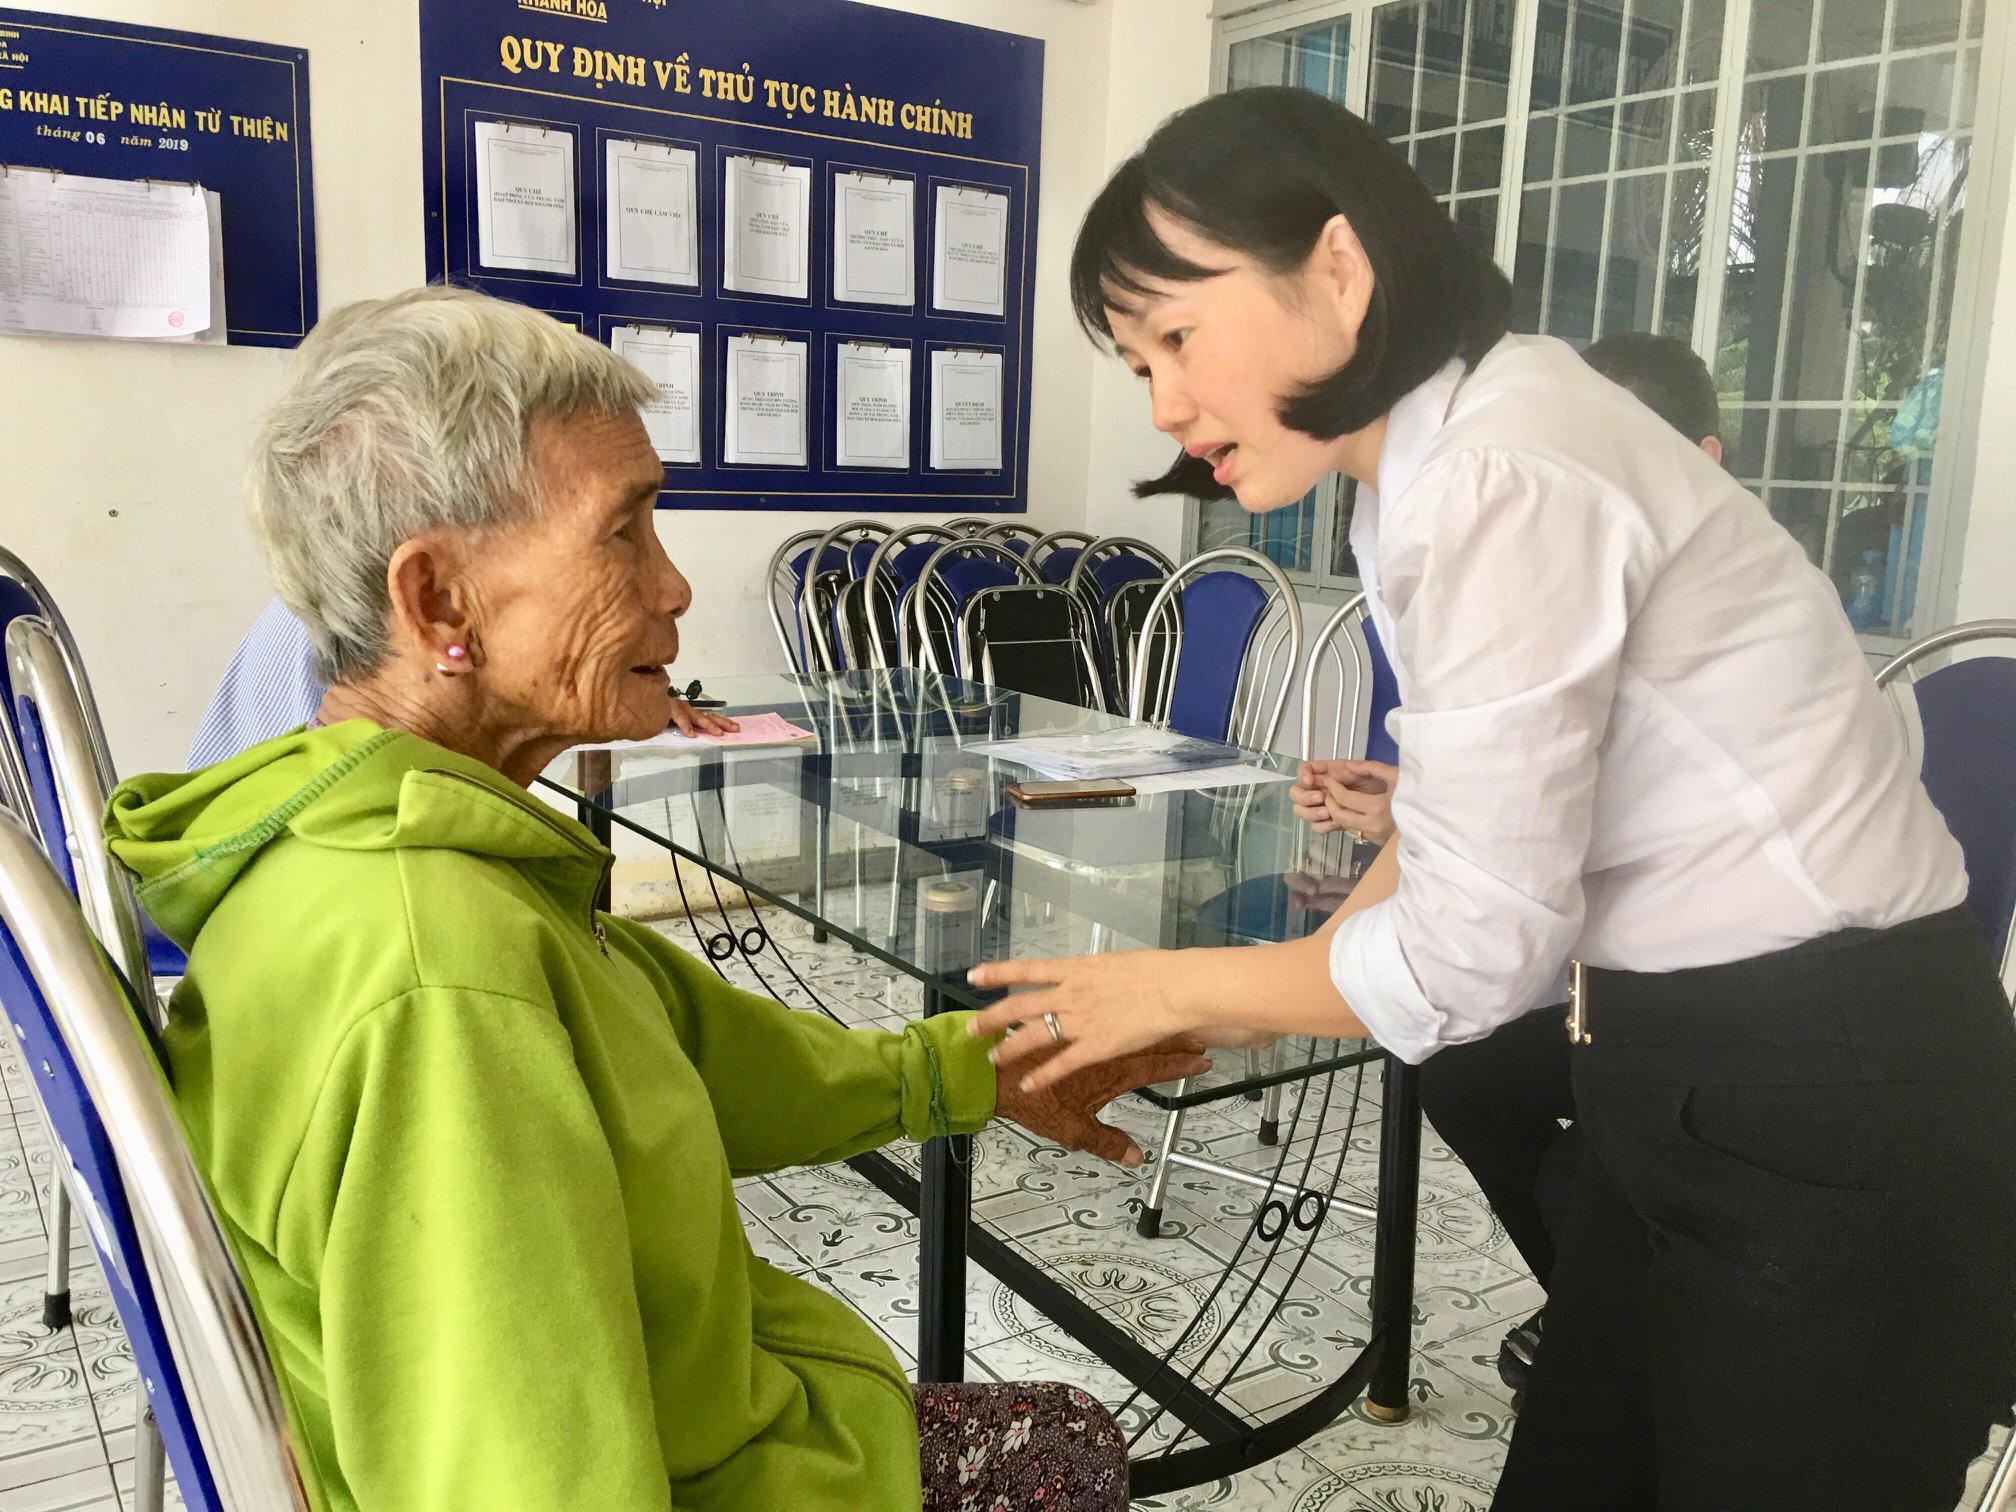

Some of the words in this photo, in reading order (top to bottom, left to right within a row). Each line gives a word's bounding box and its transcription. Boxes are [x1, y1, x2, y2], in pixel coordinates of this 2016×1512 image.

[500, 35, 565, 74] QUY
[572, 46, 646, 89] ĐỊNH
[653, 52, 692, 94] VỀ
[698, 62, 755, 103] THỦ
[763, 79, 816, 119] TỤC
[823, 83, 894, 127] HÀNH
[900, 99, 973, 139] CHÍNH
[19, 90, 69, 116] KHAI
[75, 92, 124, 121] TIẾP
[130, 102, 186, 132] NHẬN
[194, 107, 222, 133] TỪ
[229, 115, 289, 143] THIỆN
[36, 125, 81, 142] tháng
[85, 131, 106, 145] 06
[120, 134, 153, 147] năm
[158, 138, 189, 151] 2019
